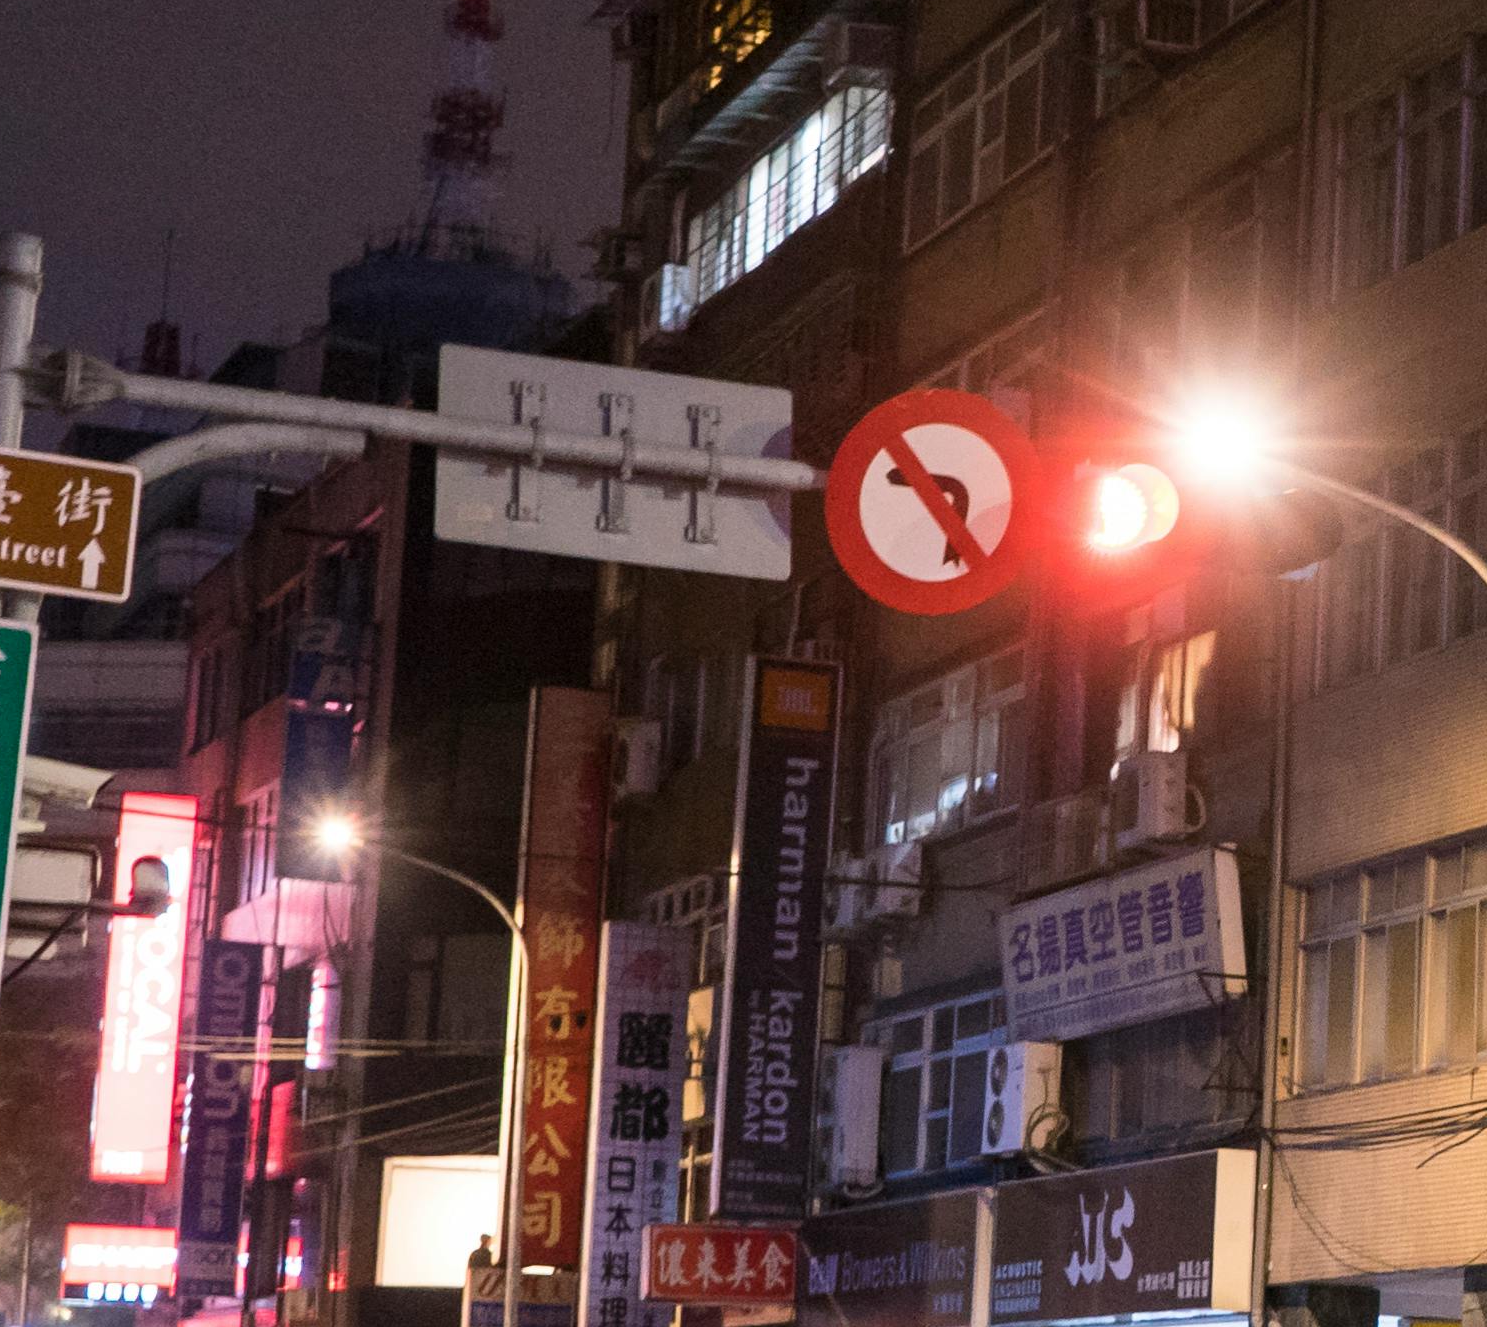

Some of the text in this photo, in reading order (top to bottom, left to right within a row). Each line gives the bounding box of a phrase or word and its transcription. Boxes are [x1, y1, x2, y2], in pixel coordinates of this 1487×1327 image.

[772, 756, 819, 961] harman
[1010, 871, 1206, 985] 名揚真空管音響
[742, 1013, 766, 1144] HARMAN
[762, 989, 804, 1145] kardon
